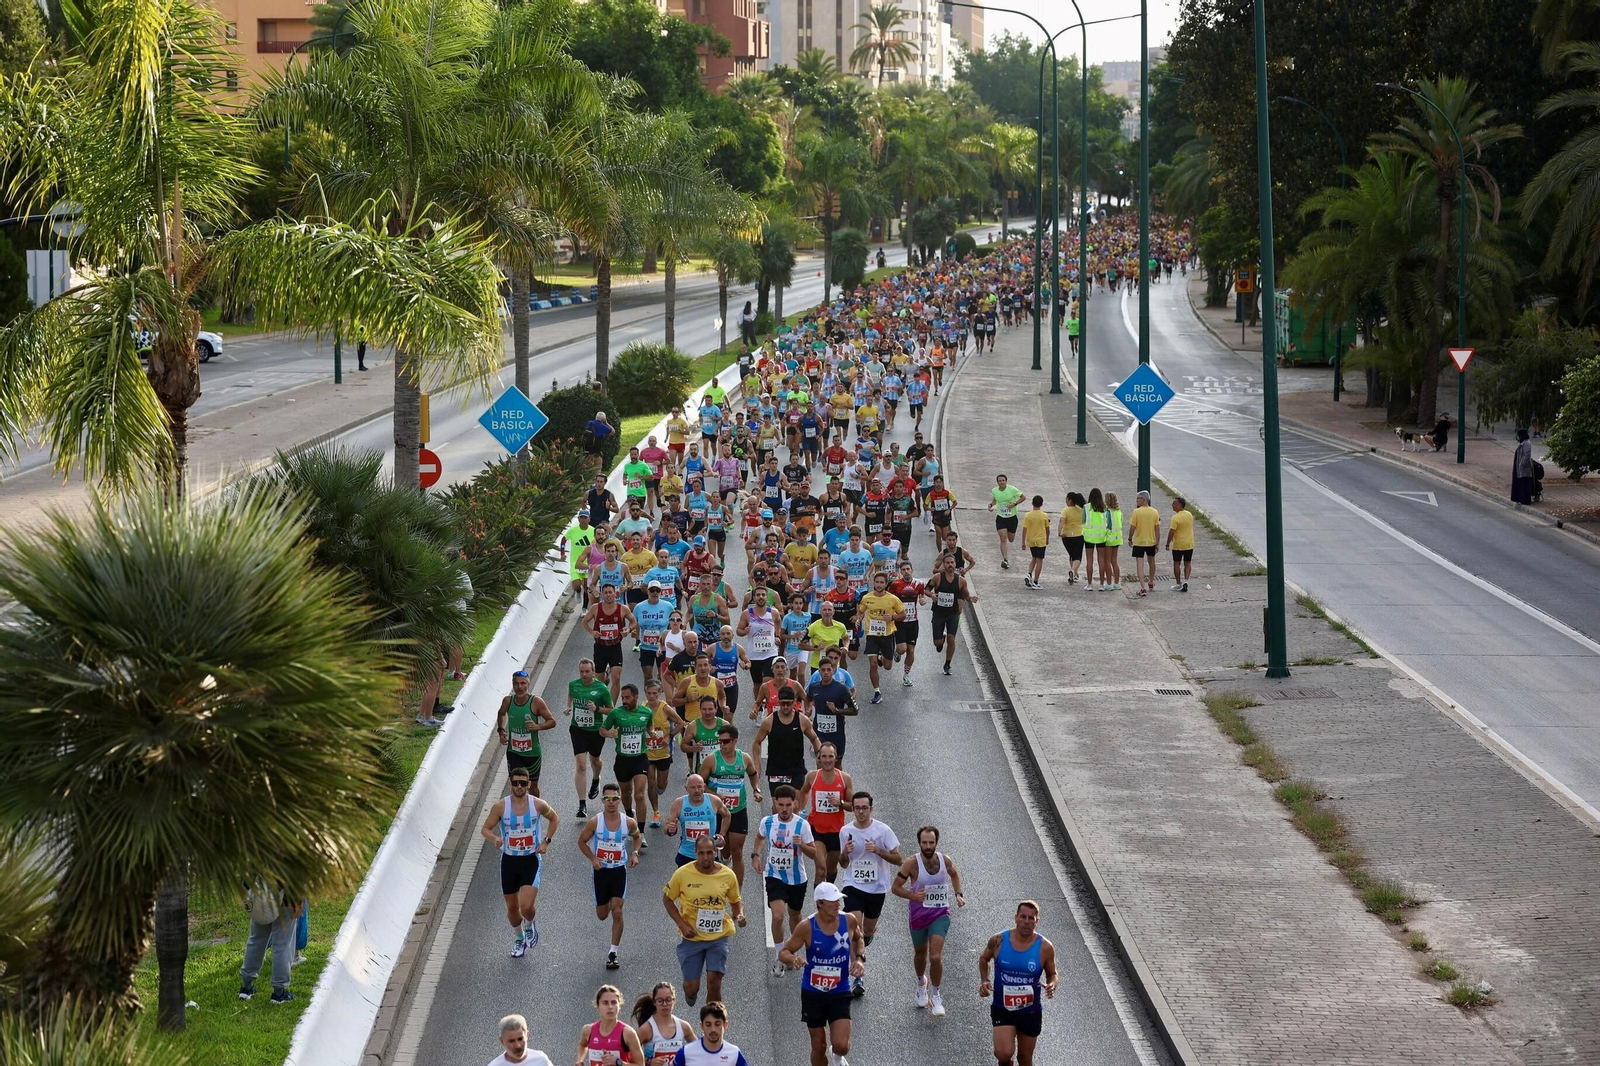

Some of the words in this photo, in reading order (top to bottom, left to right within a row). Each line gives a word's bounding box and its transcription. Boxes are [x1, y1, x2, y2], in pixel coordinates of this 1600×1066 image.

[1133, 384, 1155, 393] RED
[501, 410, 524, 419] RED
[575, 716, 594, 724] 6458
[514, 741, 529, 749] 144
[622, 742, 640, 750] 6457
[683, 810, 706, 818] nerja
[515, 839, 526, 848] 21
[603, 852, 614, 860] 30
[771, 856, 791, 866] 6441
[854, 870, 875, 878] 2541
[699, 919, 721, 928] 2805
[816, 976, 836, 988] 187
[1009, 997, 1028, 1006] 191
